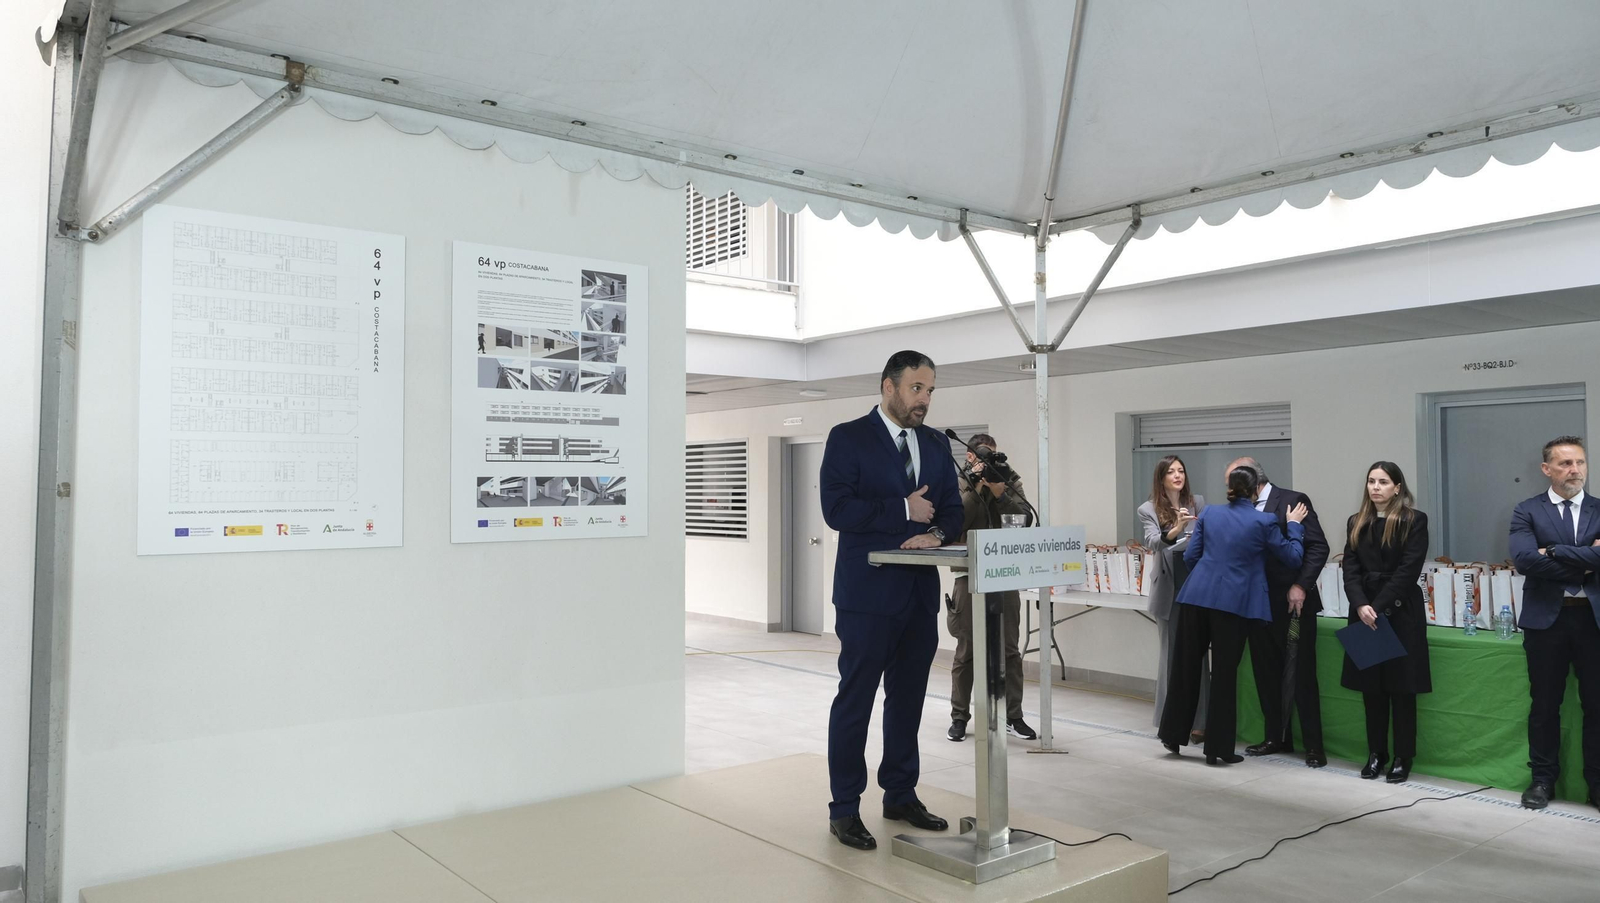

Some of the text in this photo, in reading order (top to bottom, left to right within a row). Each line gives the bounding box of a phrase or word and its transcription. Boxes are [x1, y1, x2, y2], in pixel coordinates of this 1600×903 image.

[374, 248, 381, 270] 64
[478, 256, 549, 272] 64 vp COSTACABANA
[374, 278, 381, 300] vp
[983, 537, 1081, 556] 64 nuevas viviendas
[984, 563, 1021, 579] ALMERÍA
